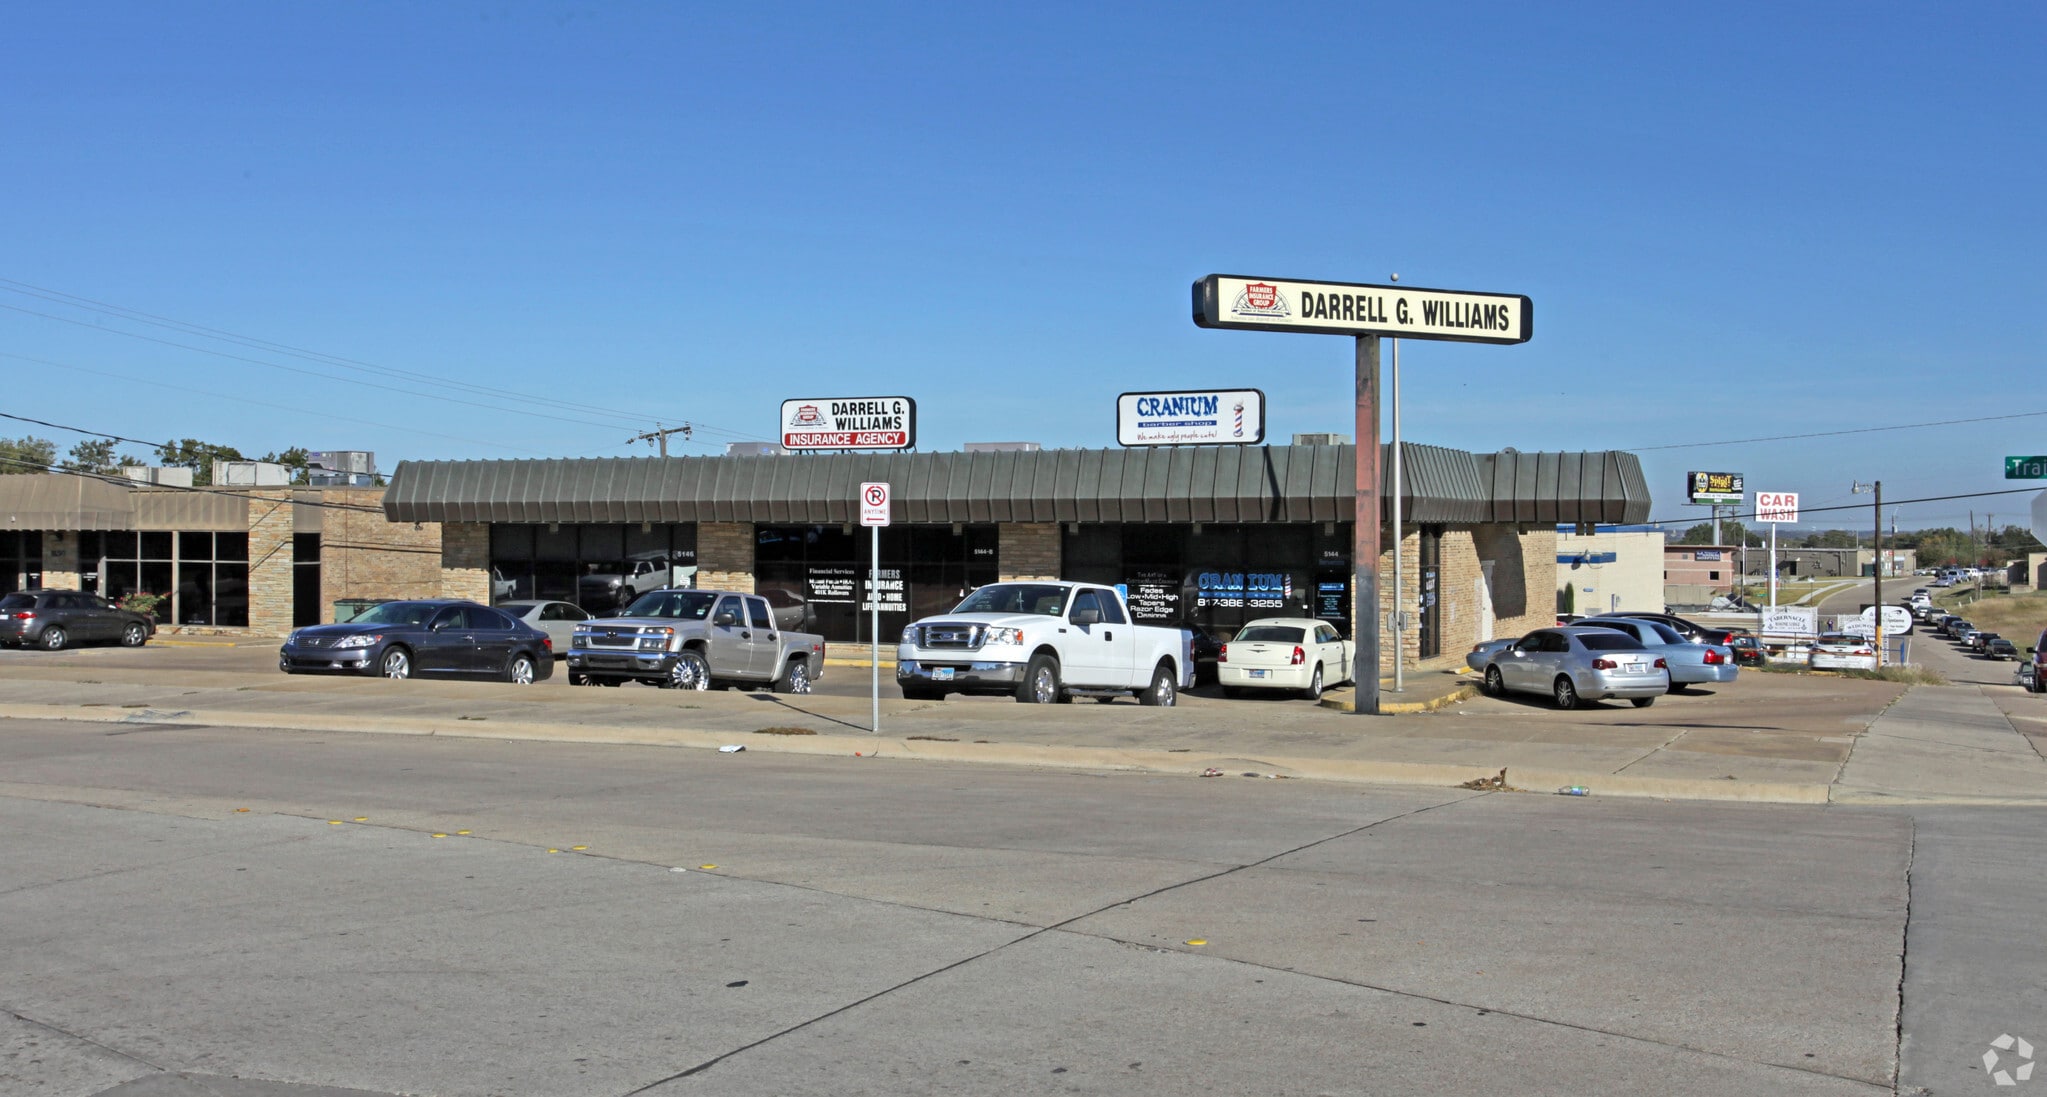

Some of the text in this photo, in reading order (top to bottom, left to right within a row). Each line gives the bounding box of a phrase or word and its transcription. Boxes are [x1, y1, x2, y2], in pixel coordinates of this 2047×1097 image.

[1302, 291, 1509, 331] DARRELL G. WILLIAMS
[832, 401, 905, 416] DARRELL G.
[1137, 395, 1219, 418] CRANIUM
[835, 416, 902, 431] WILLIAMS
[790, 433, 900, 445] INSURANCE AGENCY
[1760, 494, 1795, 506] CAR
[1760, 508, 1794, 521] WASH
[869, 569, 900, 579] FRMERS
[865, 580, 903, 590] INURANCE
[886, 593, 903, 601] HOME
